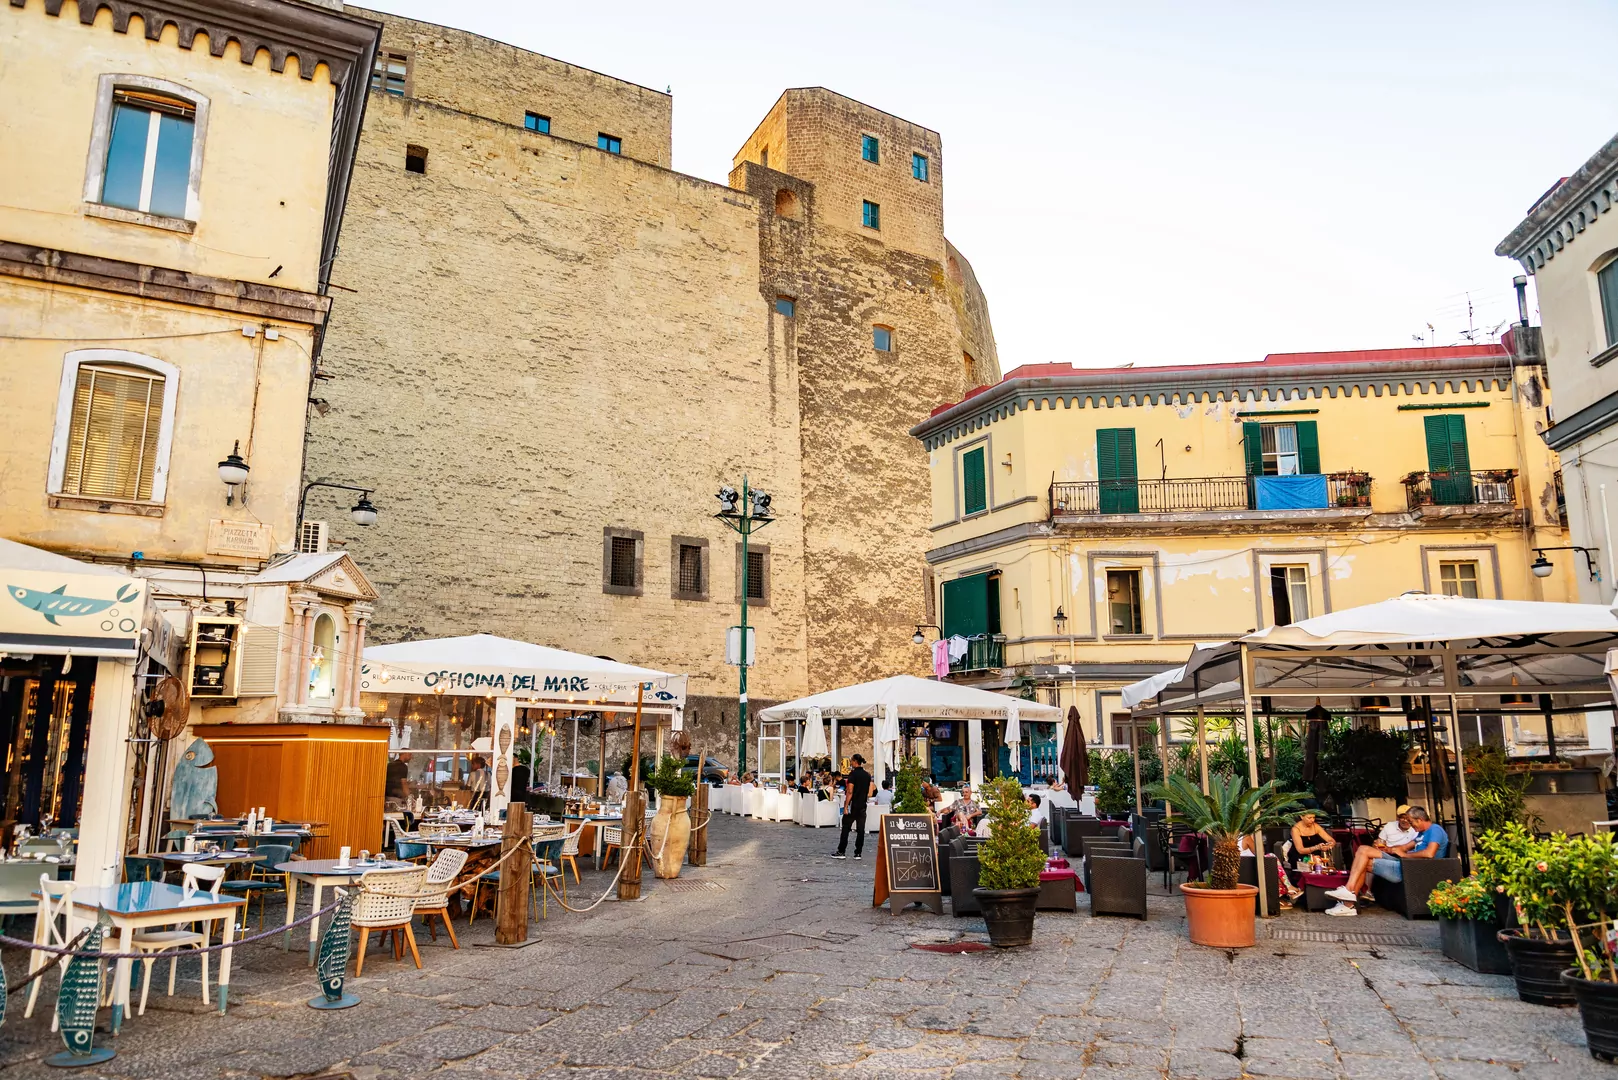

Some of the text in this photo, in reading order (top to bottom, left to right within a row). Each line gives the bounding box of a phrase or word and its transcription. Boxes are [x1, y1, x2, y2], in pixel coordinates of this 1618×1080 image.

[223, 528, 257, 538] PIAZZETTA
[372, 673, 415, 682] RIORANTE
[424, 670, 590, 693] OFFICINA DEL MARE
[904, 820, 927, 829] Grigio
[889, 833, 930, 841] COCKTAILS BAR
[911, 851, 931, 864] AMO
